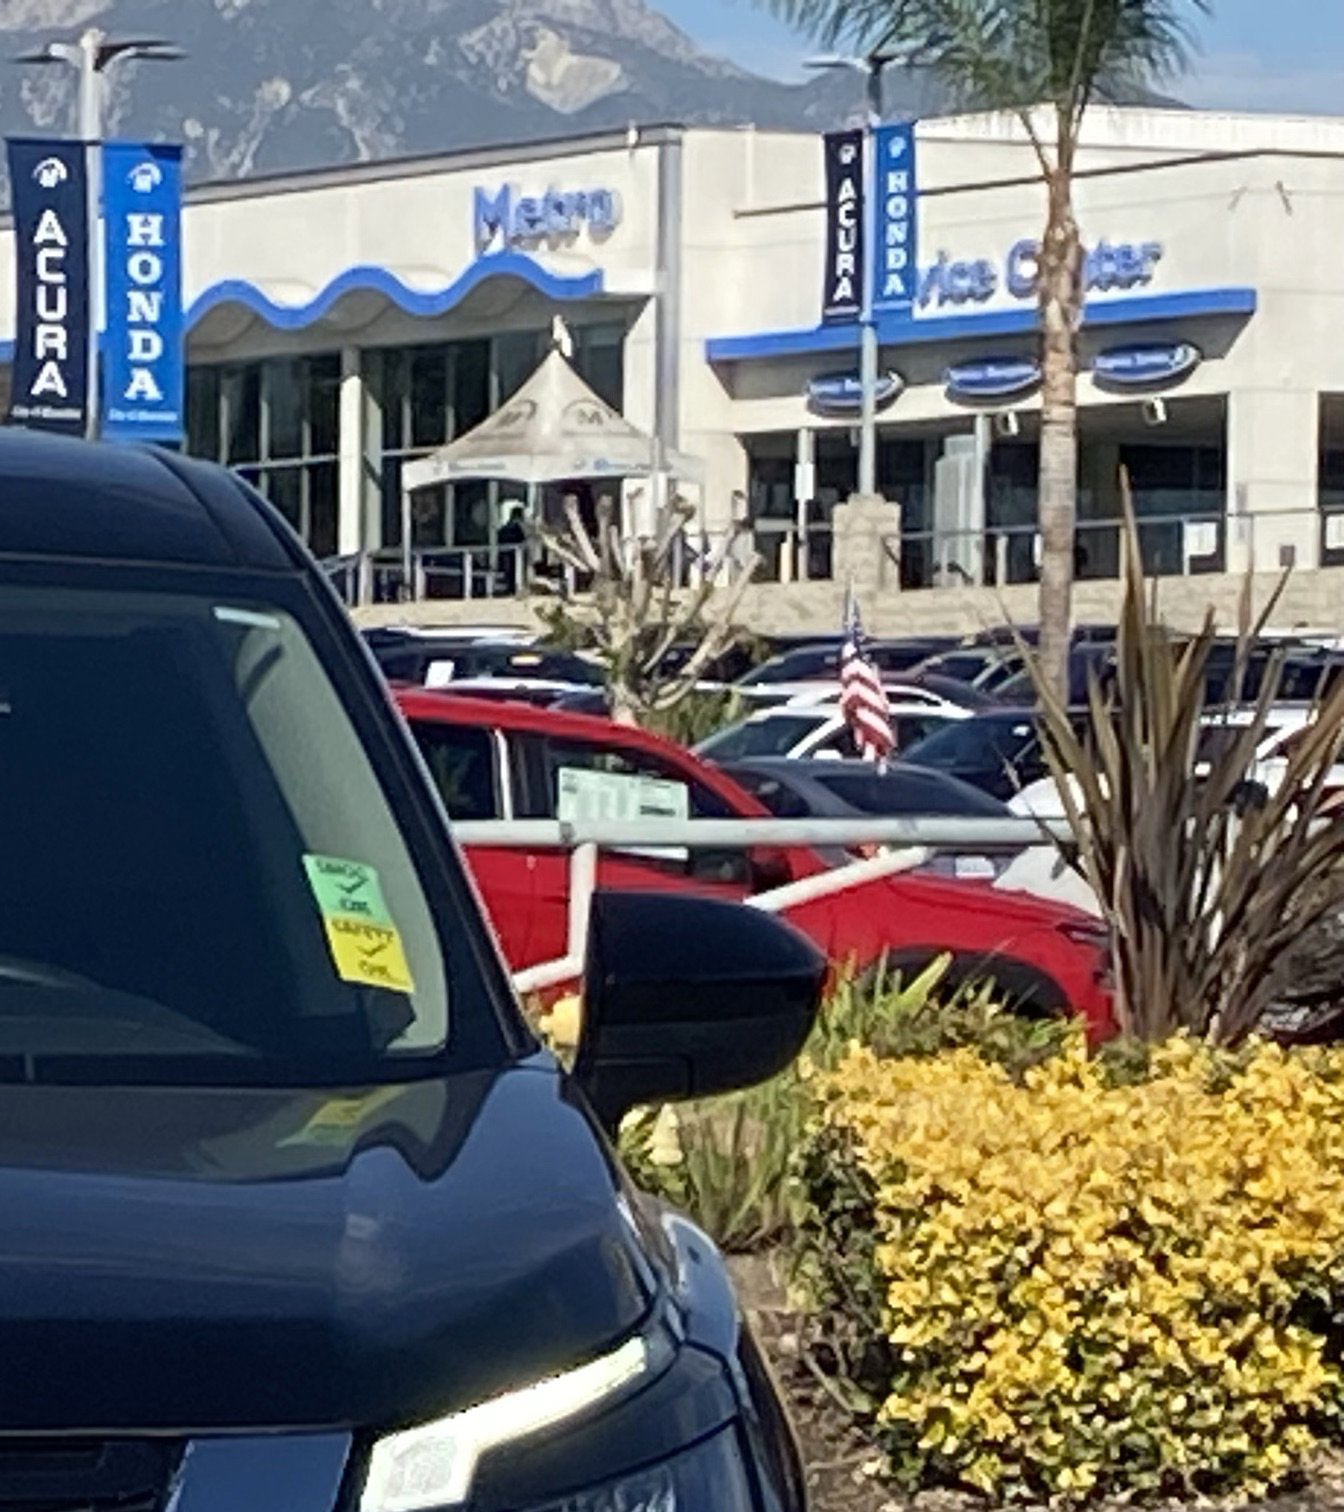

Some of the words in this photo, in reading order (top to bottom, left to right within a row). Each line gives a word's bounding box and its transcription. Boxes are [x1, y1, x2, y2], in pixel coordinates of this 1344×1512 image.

[474, 182, 622, 254] Metro
[832, 177, 856, 302] ACURA
[883, 170, 909, 297] HONDA
[29, 209, 68, 399] ACURA
[123, 212, 165, 401] HONDA
